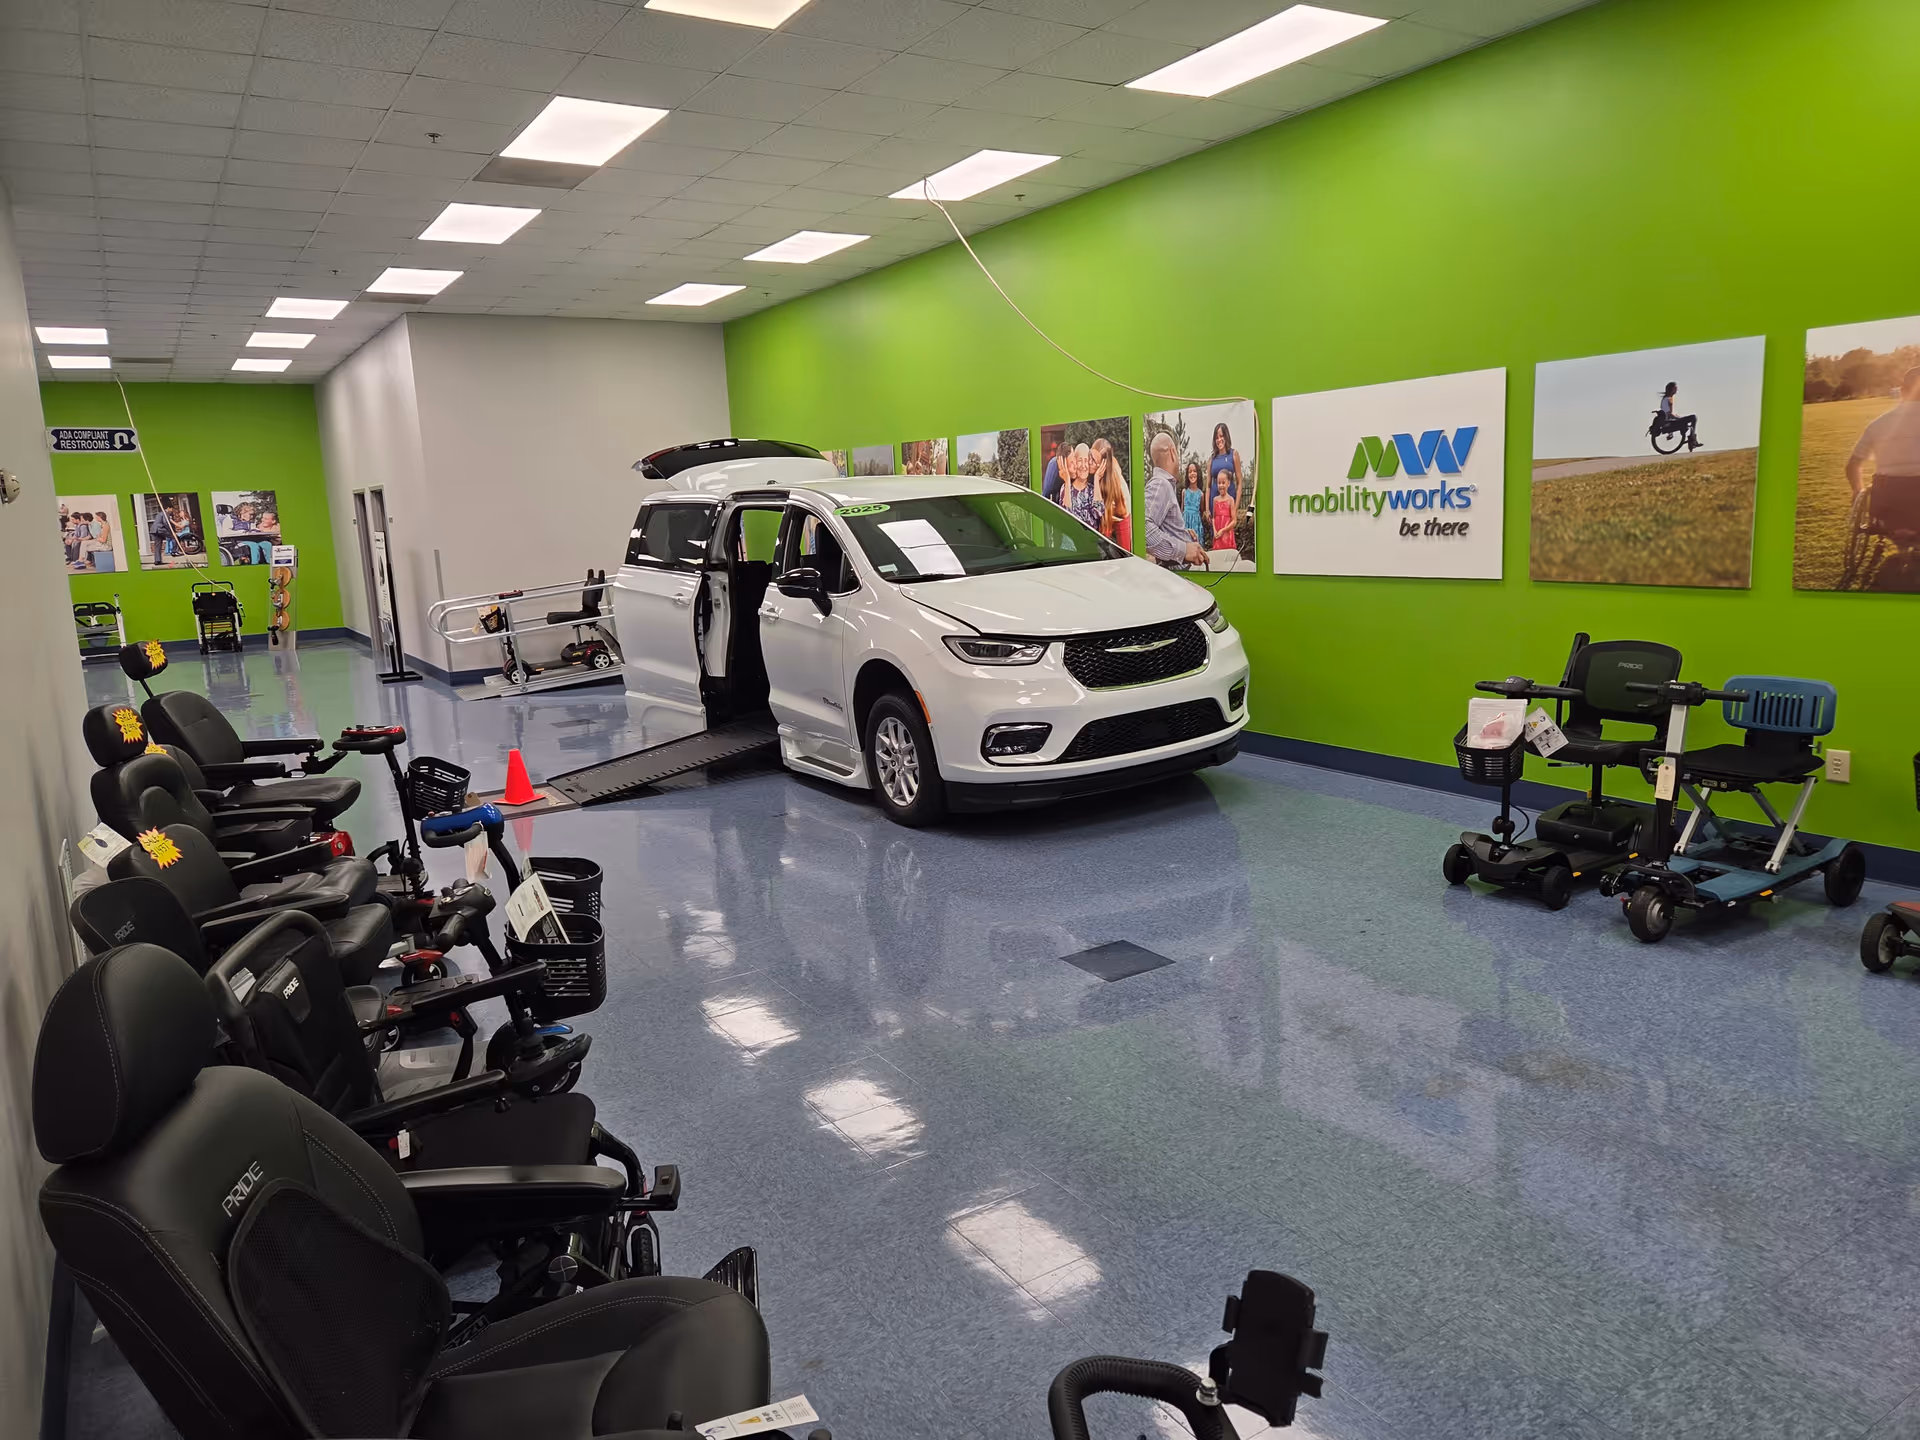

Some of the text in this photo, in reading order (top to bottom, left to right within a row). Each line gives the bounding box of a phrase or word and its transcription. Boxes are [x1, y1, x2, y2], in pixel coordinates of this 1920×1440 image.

[60, 431, 109, 440] ADA COMPLIANT
[60, 440, 110, 449] RESTROOMS
[840, 505, 882, 514] 2025
[1399, 517, 1470, 537] be there
[114, 919, 136, 942] PRIDE
[282, 976, 300, 1000] PRIDE
[221, 1160, 264, 1218] PRIDE
